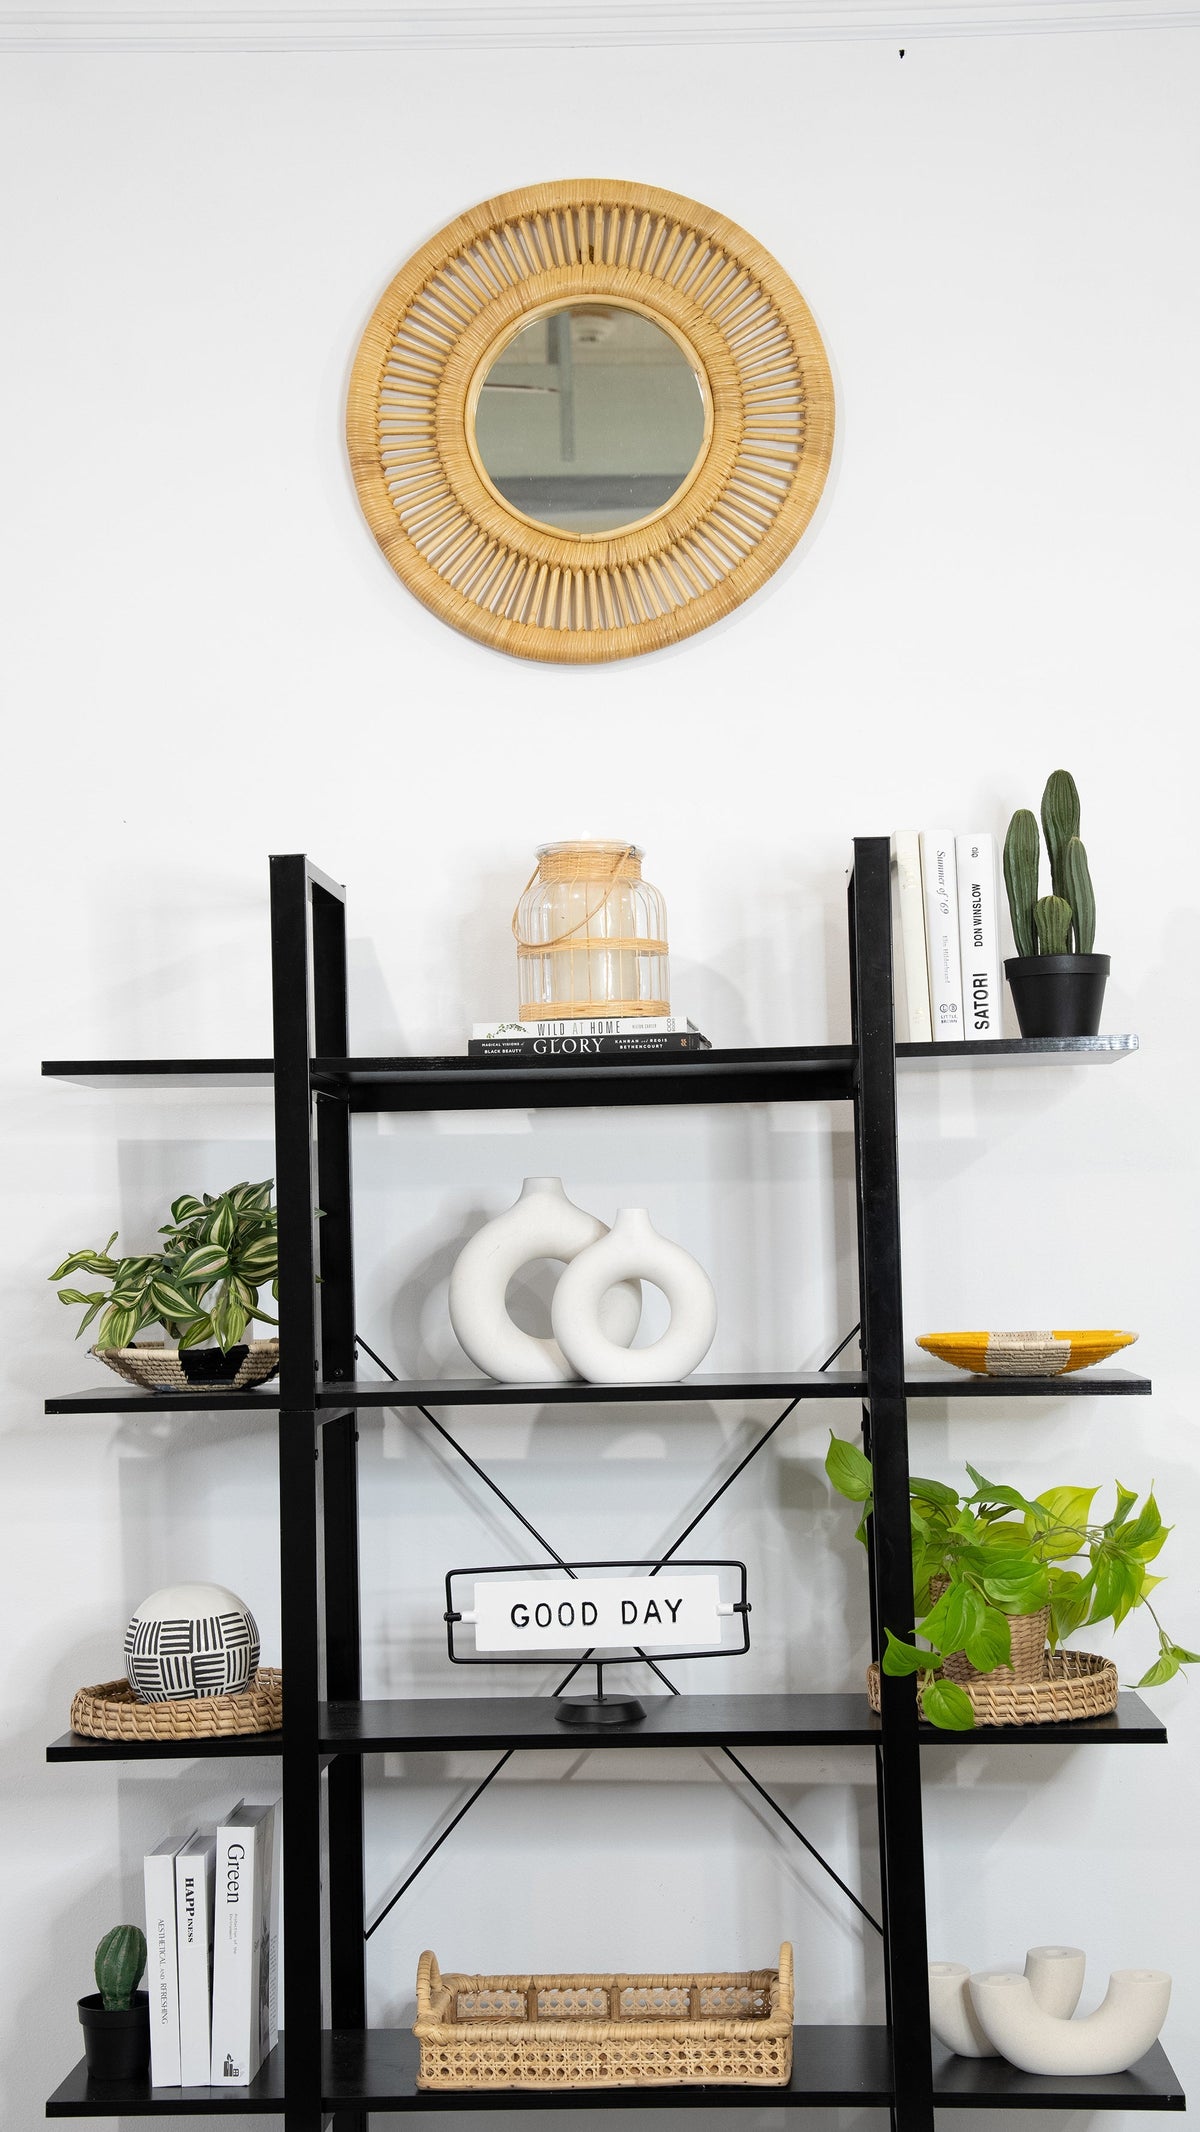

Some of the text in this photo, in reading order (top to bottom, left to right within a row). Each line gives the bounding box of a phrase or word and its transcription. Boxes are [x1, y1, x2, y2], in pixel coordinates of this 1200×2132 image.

[936, 850, 946, 886] Summer
[936, 887, 949, 898] of
[971, 883, 984, 947] DON WINSLOW
[972, 973, 990, 1030] SATORI
[533, 1038, 604, 1054] GLORY
[537, 1020, 620, 1036] WILD AT HOME
[510, 1598, 683, 1628] GOOD DAY
[226, 1843, 246, 1904] Green
[185, 1877, 195, 1943] HAPPINESS
